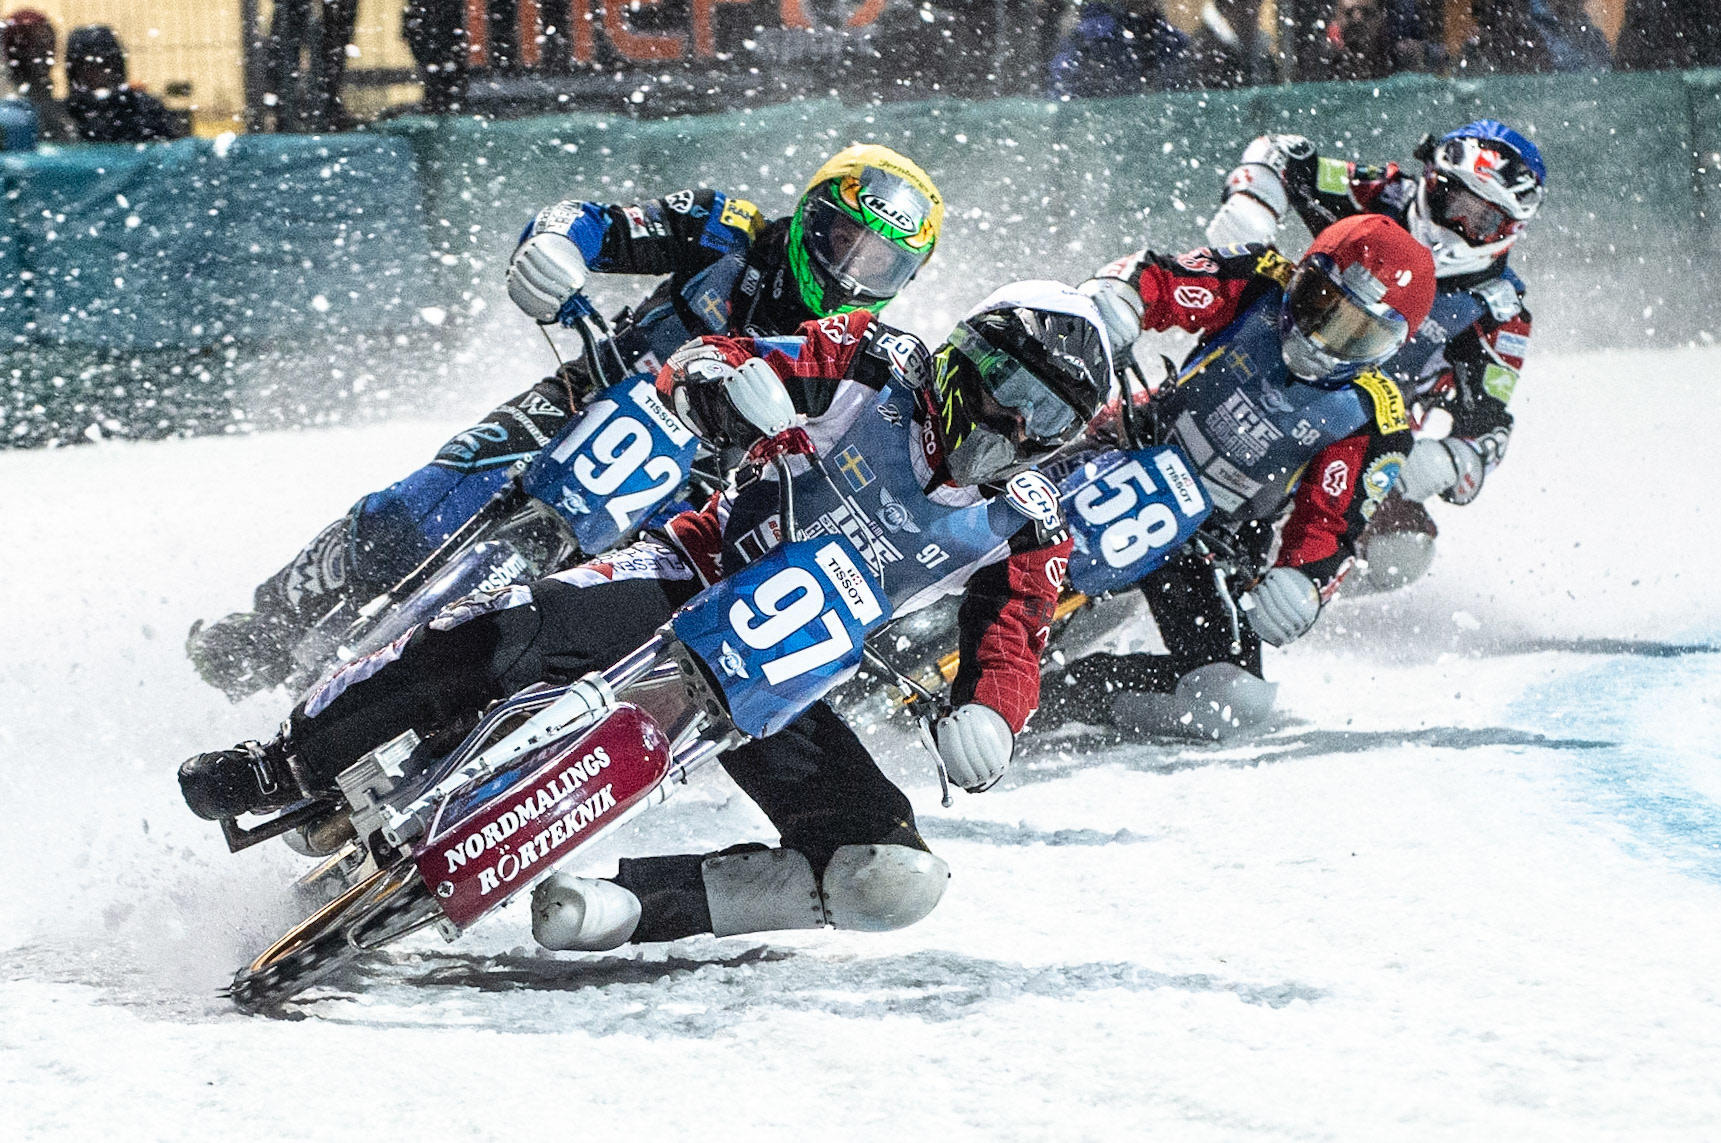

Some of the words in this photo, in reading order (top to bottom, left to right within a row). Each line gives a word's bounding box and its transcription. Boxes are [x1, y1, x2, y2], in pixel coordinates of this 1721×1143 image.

[868, 196, 911, 229] HJC
[880, 336, 926, 386] FUCH
[644, 395, 682, 434] TISSOT
[1222, 391, 1279, 449] ICE
[1290, 419, 1321, 446] 58
[550, 398, 683, 533] 192
[1165, 463, 1194, 504] TISSOT
[885, 504, 904, 527] FIM
[1015, 476, 1058, 526] UCHS
[1073, 459, 1179, 569] 58
[915, 543, 951, 570] 97
[826, 557, 866, 608] TISSOT
[728, 566, 855, 687] 97
[444, 746, 611, 874] NORDMALINGS
[477, 783, 617, 896] RÖRTEKNIK
